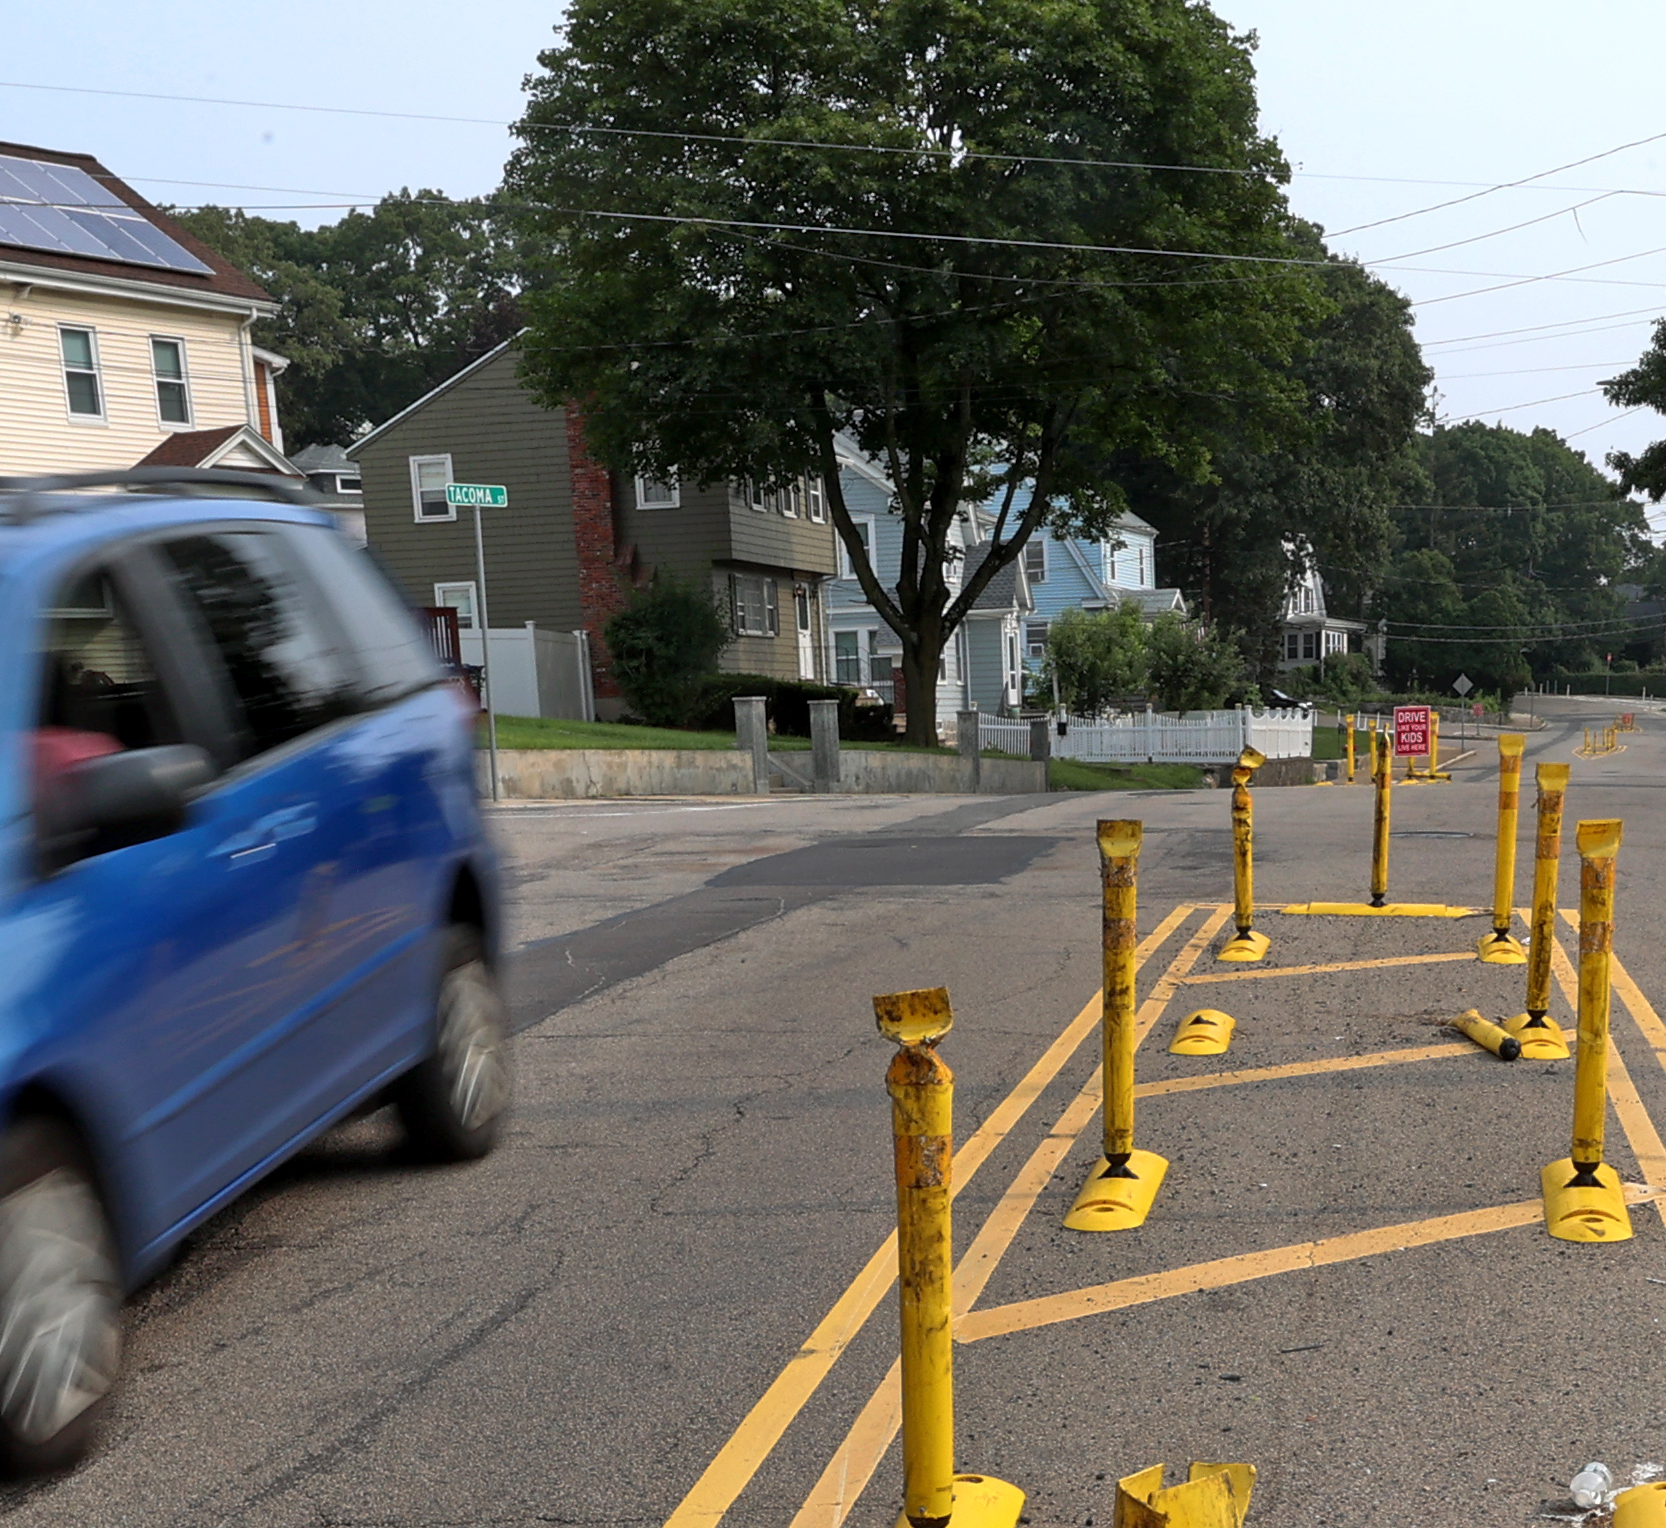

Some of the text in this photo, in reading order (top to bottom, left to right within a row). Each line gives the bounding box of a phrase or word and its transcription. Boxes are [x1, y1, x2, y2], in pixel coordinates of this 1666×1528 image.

[449, 487, 504, 504] TACOMA ST
[1398, 711, 1426, 723] DRIVE
[1411, 723, 1427, 731] YOUR
[1401, 731, 1423, 743] KIDS
